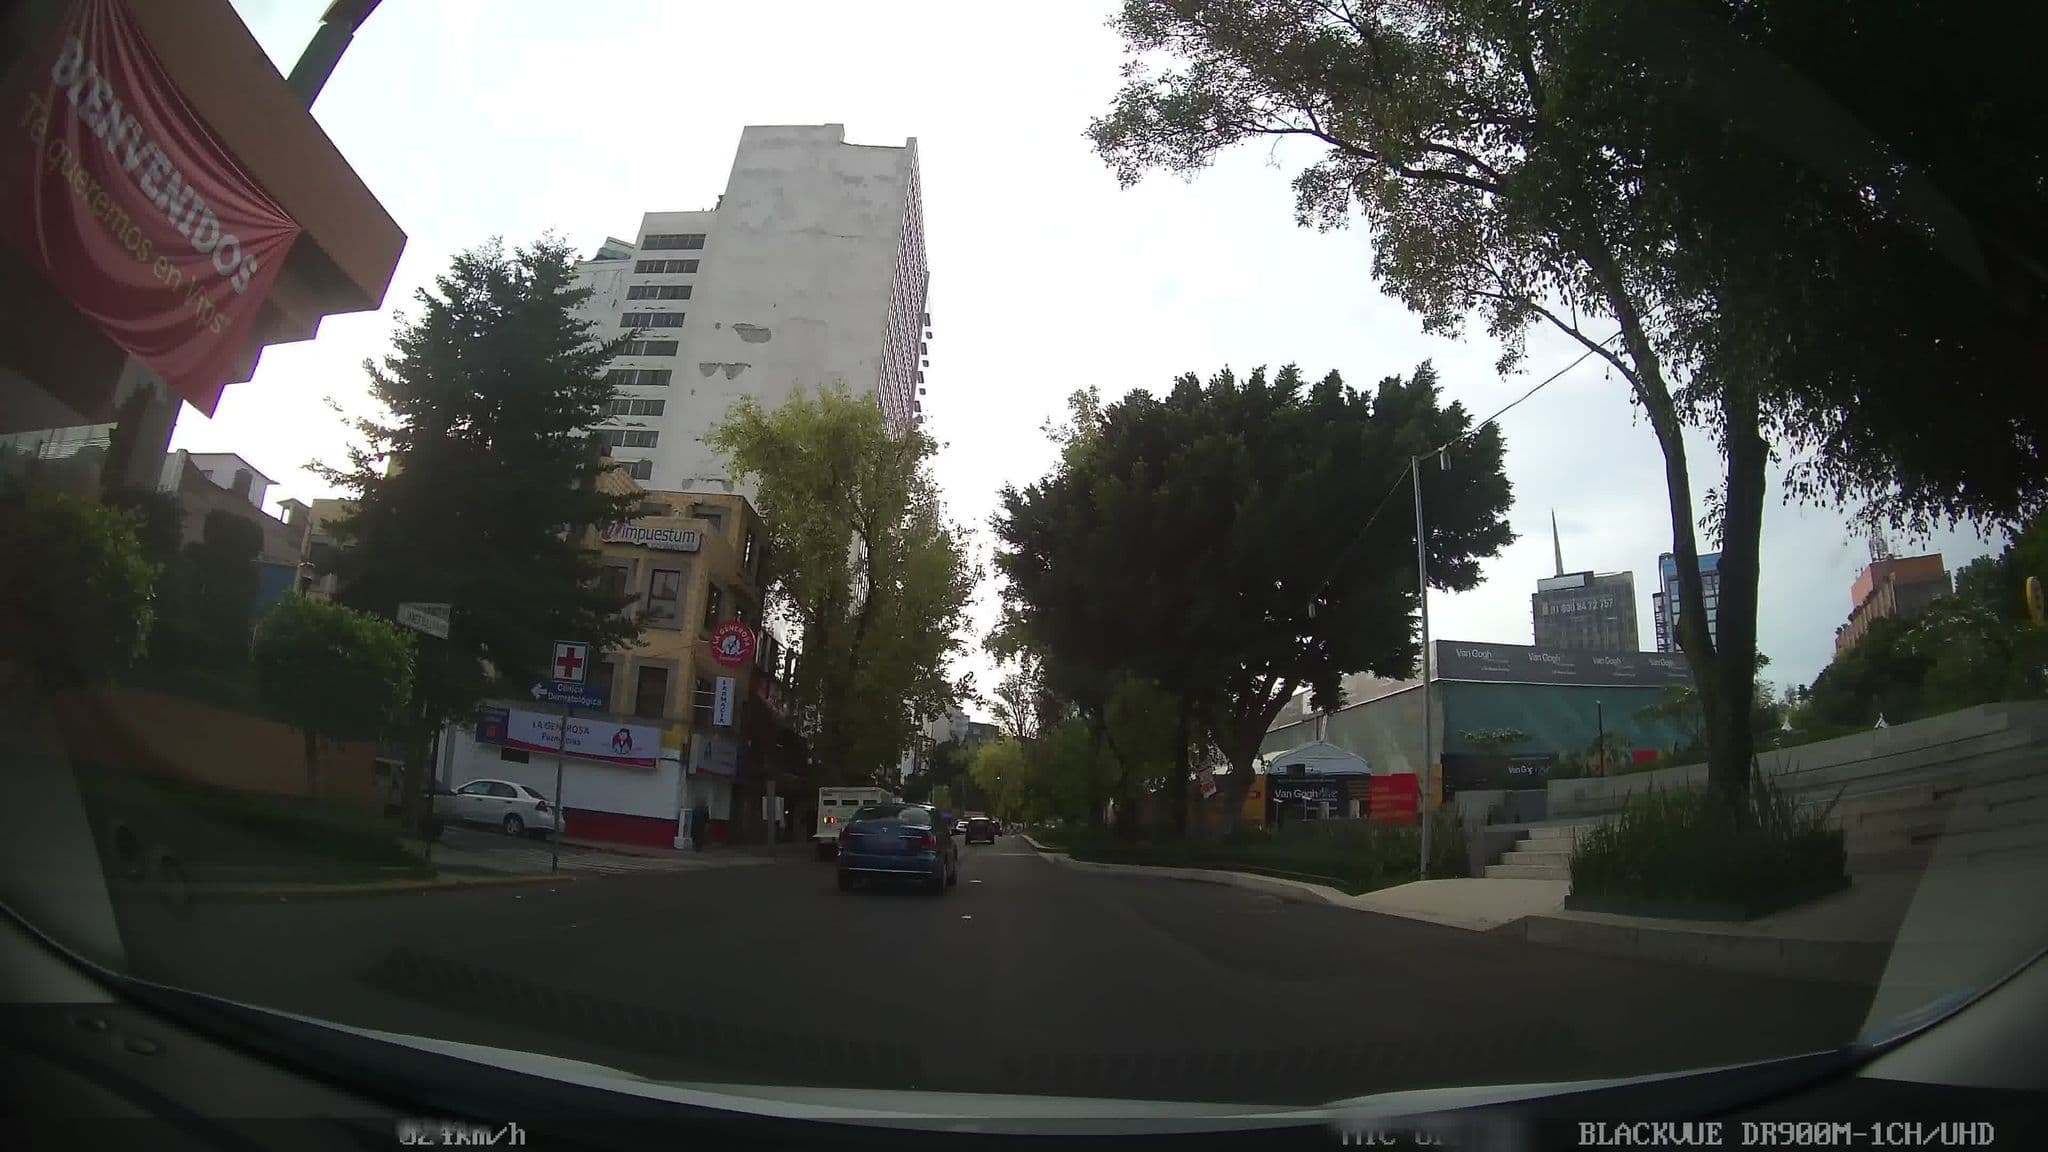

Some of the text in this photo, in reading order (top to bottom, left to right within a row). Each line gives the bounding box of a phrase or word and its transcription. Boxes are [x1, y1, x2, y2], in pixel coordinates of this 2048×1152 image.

[52, 36, 257, 294] BIENVENIDOS
[48, 137, 153, 263] queremos
[153, 254, 183, 292] en
[621, 524, 696, 543] impuestum
[1455, 647, 1492, 660] Van Gogh
[1527, 652, 1542, 663] Van
[1542, 652, 1561, 665] Gogh
[544, 721, 590, 736] GENROSA
[1274, 788, 1293, 799] Van
[1293, 788, 1319, 801] Gogh
